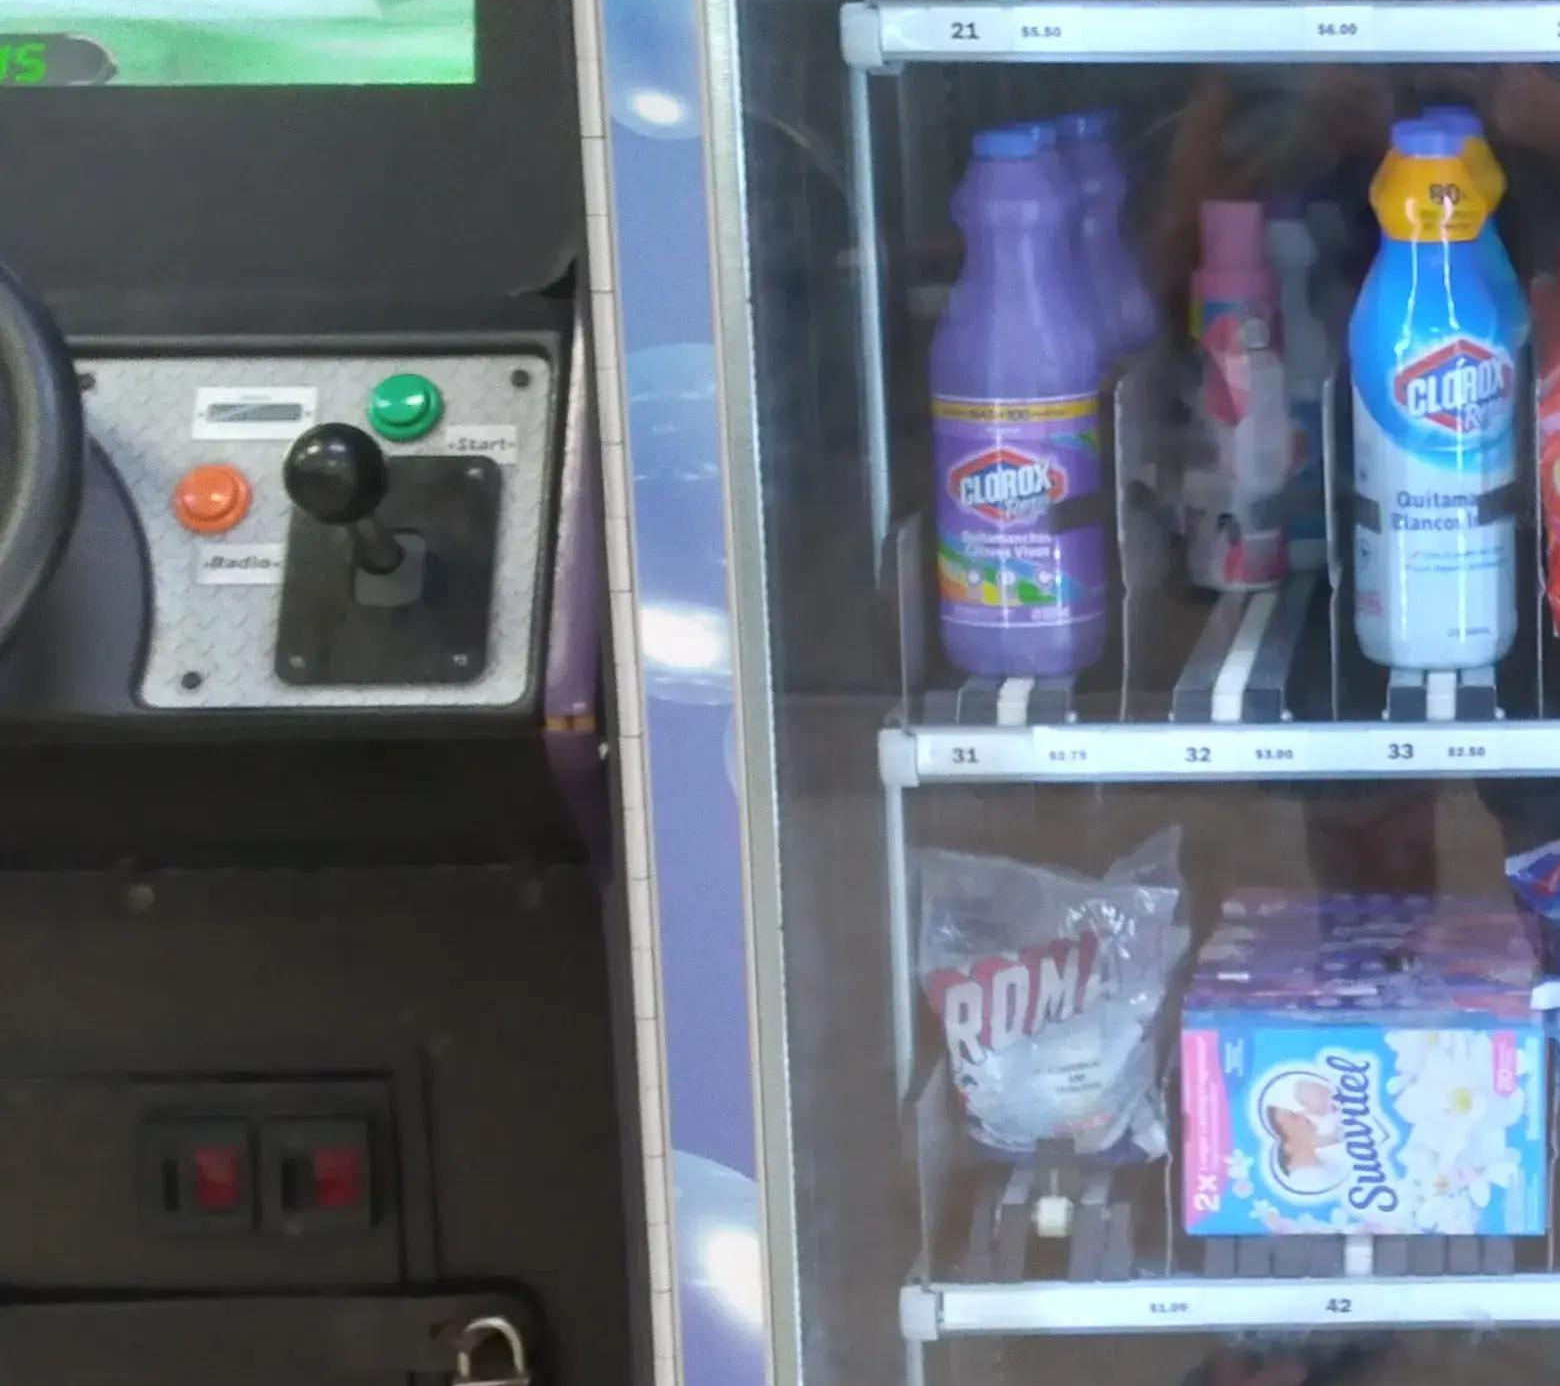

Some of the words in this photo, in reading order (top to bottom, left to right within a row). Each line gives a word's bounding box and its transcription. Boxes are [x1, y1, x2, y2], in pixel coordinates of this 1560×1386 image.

[950, 21, 981, 40] 21
[1406, 349, 1514, 419] CLOROX
[960, 459, 1054, 506] CLOROX
[1396, 490, 1478, 509] Quitama
[951, 746, 980, 764] 31
[1184, 746, 1213, 763] 32
[1387, 742, 1415, 760] 33
[1325, 1054, 1399, 1213] Suavitel
[1325, 1297, 1354, 1314] 42
